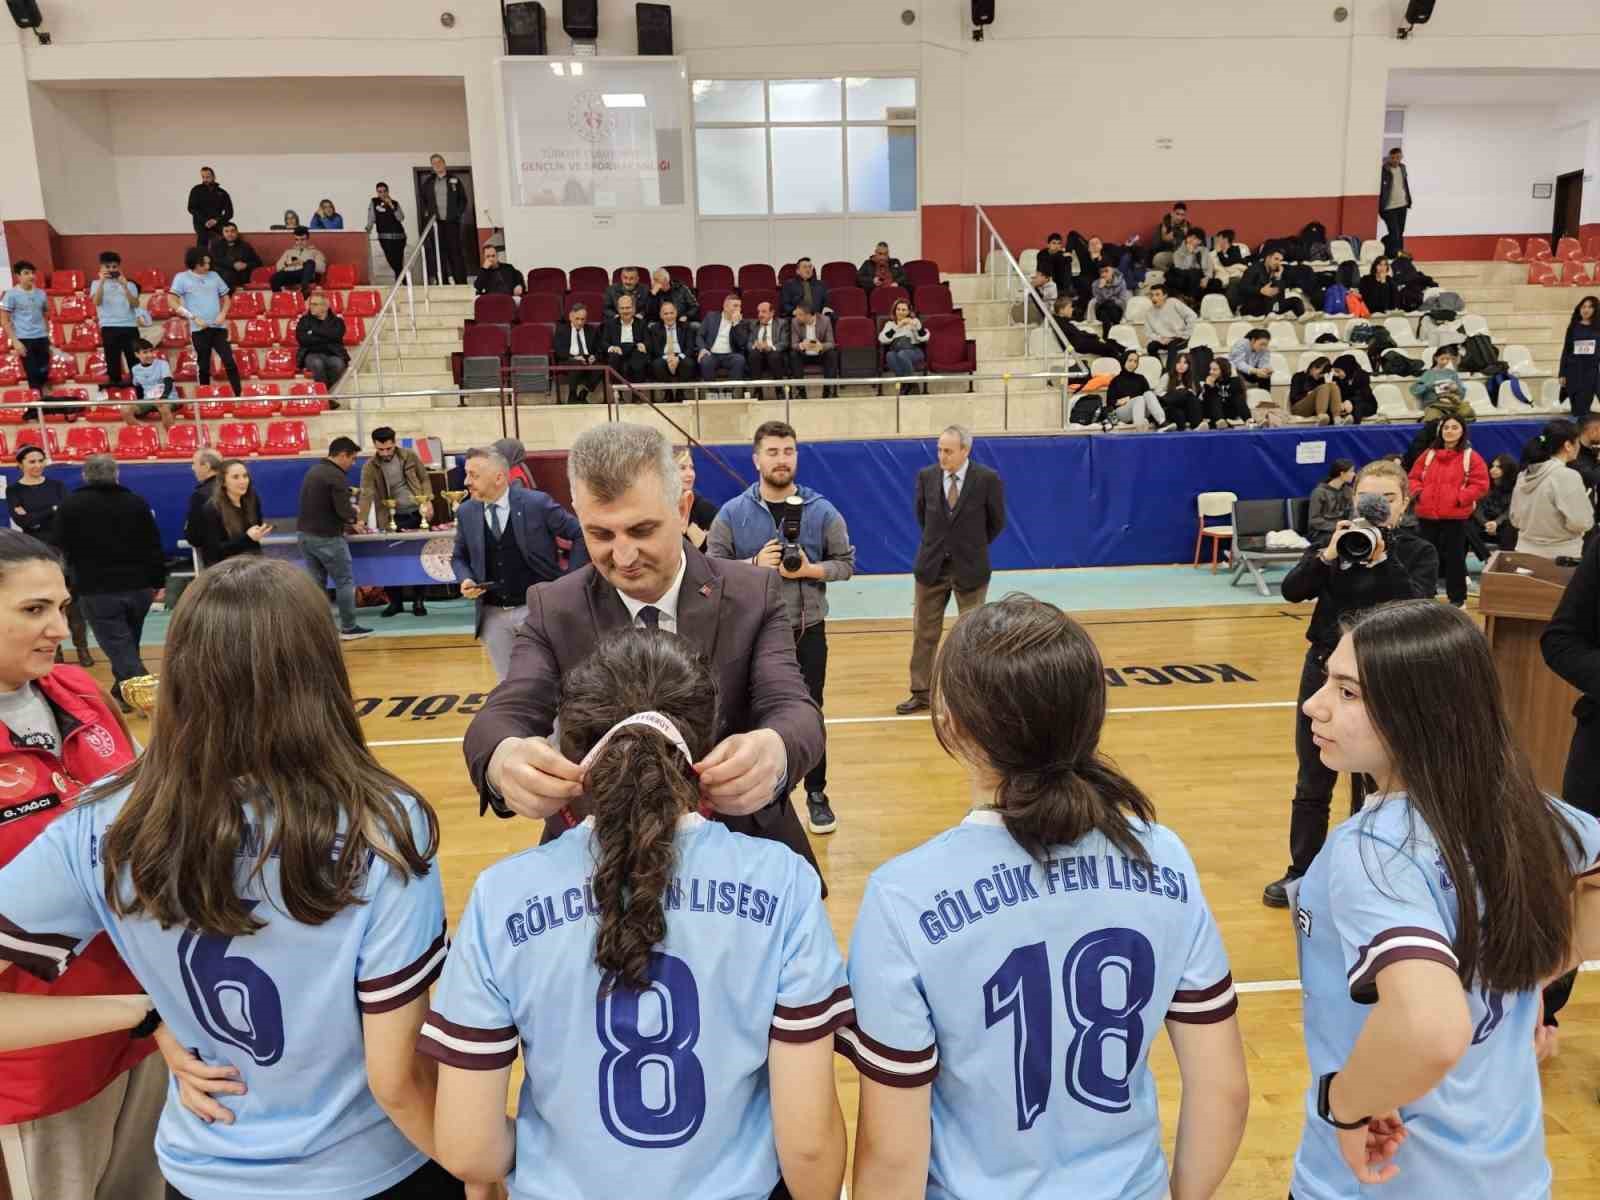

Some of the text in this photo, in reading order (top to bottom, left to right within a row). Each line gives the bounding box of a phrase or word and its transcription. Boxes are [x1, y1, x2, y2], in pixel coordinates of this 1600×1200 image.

[177, 899, 285, 1067] 6
[919, 862, 1040, 945] GÖLCÜK
[1043, 855, 1100, 895] FEN
[596, 949, 706, 1149] 8
[983, 927, 1156, 1131] 18
